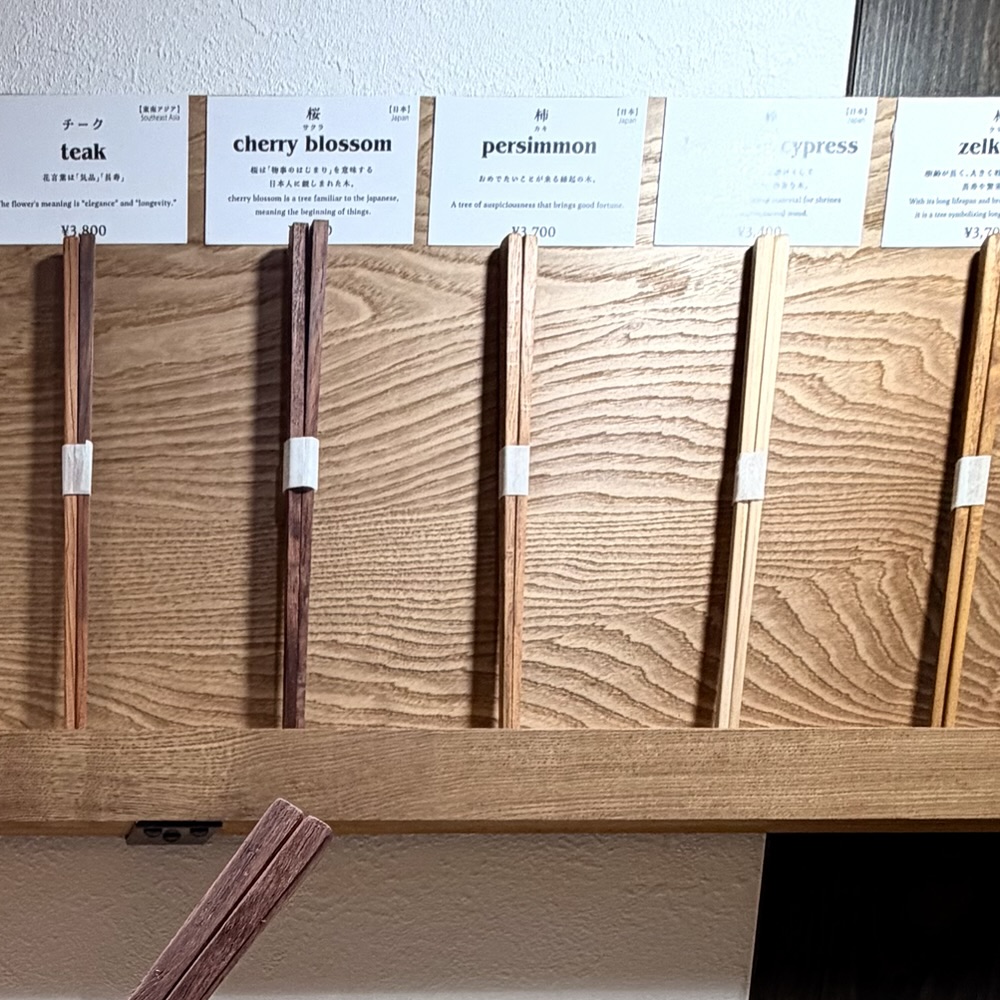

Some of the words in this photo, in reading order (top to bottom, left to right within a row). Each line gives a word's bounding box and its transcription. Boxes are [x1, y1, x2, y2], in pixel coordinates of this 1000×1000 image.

[139, 112, 167, 121] Southeast
[169, 112, 180, 121] Asia
[306, 107, 320, 120] 桜
[534, 108, 548, 122] 柿
[63, 118, 103, 130] チーク
[61, 144, 106, 160] teak
[234, 136, 298, 156] cherry
[306, 136, 391, 152] blossom
[482, 136, 596, 158] persimmon
[782, 141, 858, 158] cypress
[12, 199, 39, 209] flower's
[41, 199, 72, 209] meaning
[74, 199, 80, 208] is
[82, 199, 118, 208] "elegance"
[120, 198, 133, 207] and
[136, 199, 176, 208] "longevity."
[228, 194, 251, 204] cherry
[253, 193, 282, 203] blossom
[284, 193, 290, 203] is
[292, 195, 296, 203] a
[298, 195, 311, 203] tree
[314, 193, 342, 203] familiar
[354, 193, 364, 202] the
[367, 194, 399, 203] japanese,
[451, 200, 456, 209] A
[458, 201, 472, 209] tree
[474, 199, 482, 209] of
[483, 201, 535, 211] auspiciousness
[538, 200, 551, 209] that
[554, 201, 576, 210] brings
[578, 201, 594, 211] good
[597, 201, 622, 209] fortune.
[255, 208, 286, 217] meaning
[288, 207, 298, 216] the
[301, 207, 336, 217] beginning
[338, 207, 345, 216] of
[347, 207, 371, 217] things.
[62, 225, 106, 236] ¥3800
[512, 226, 556, 237] ¥3700
